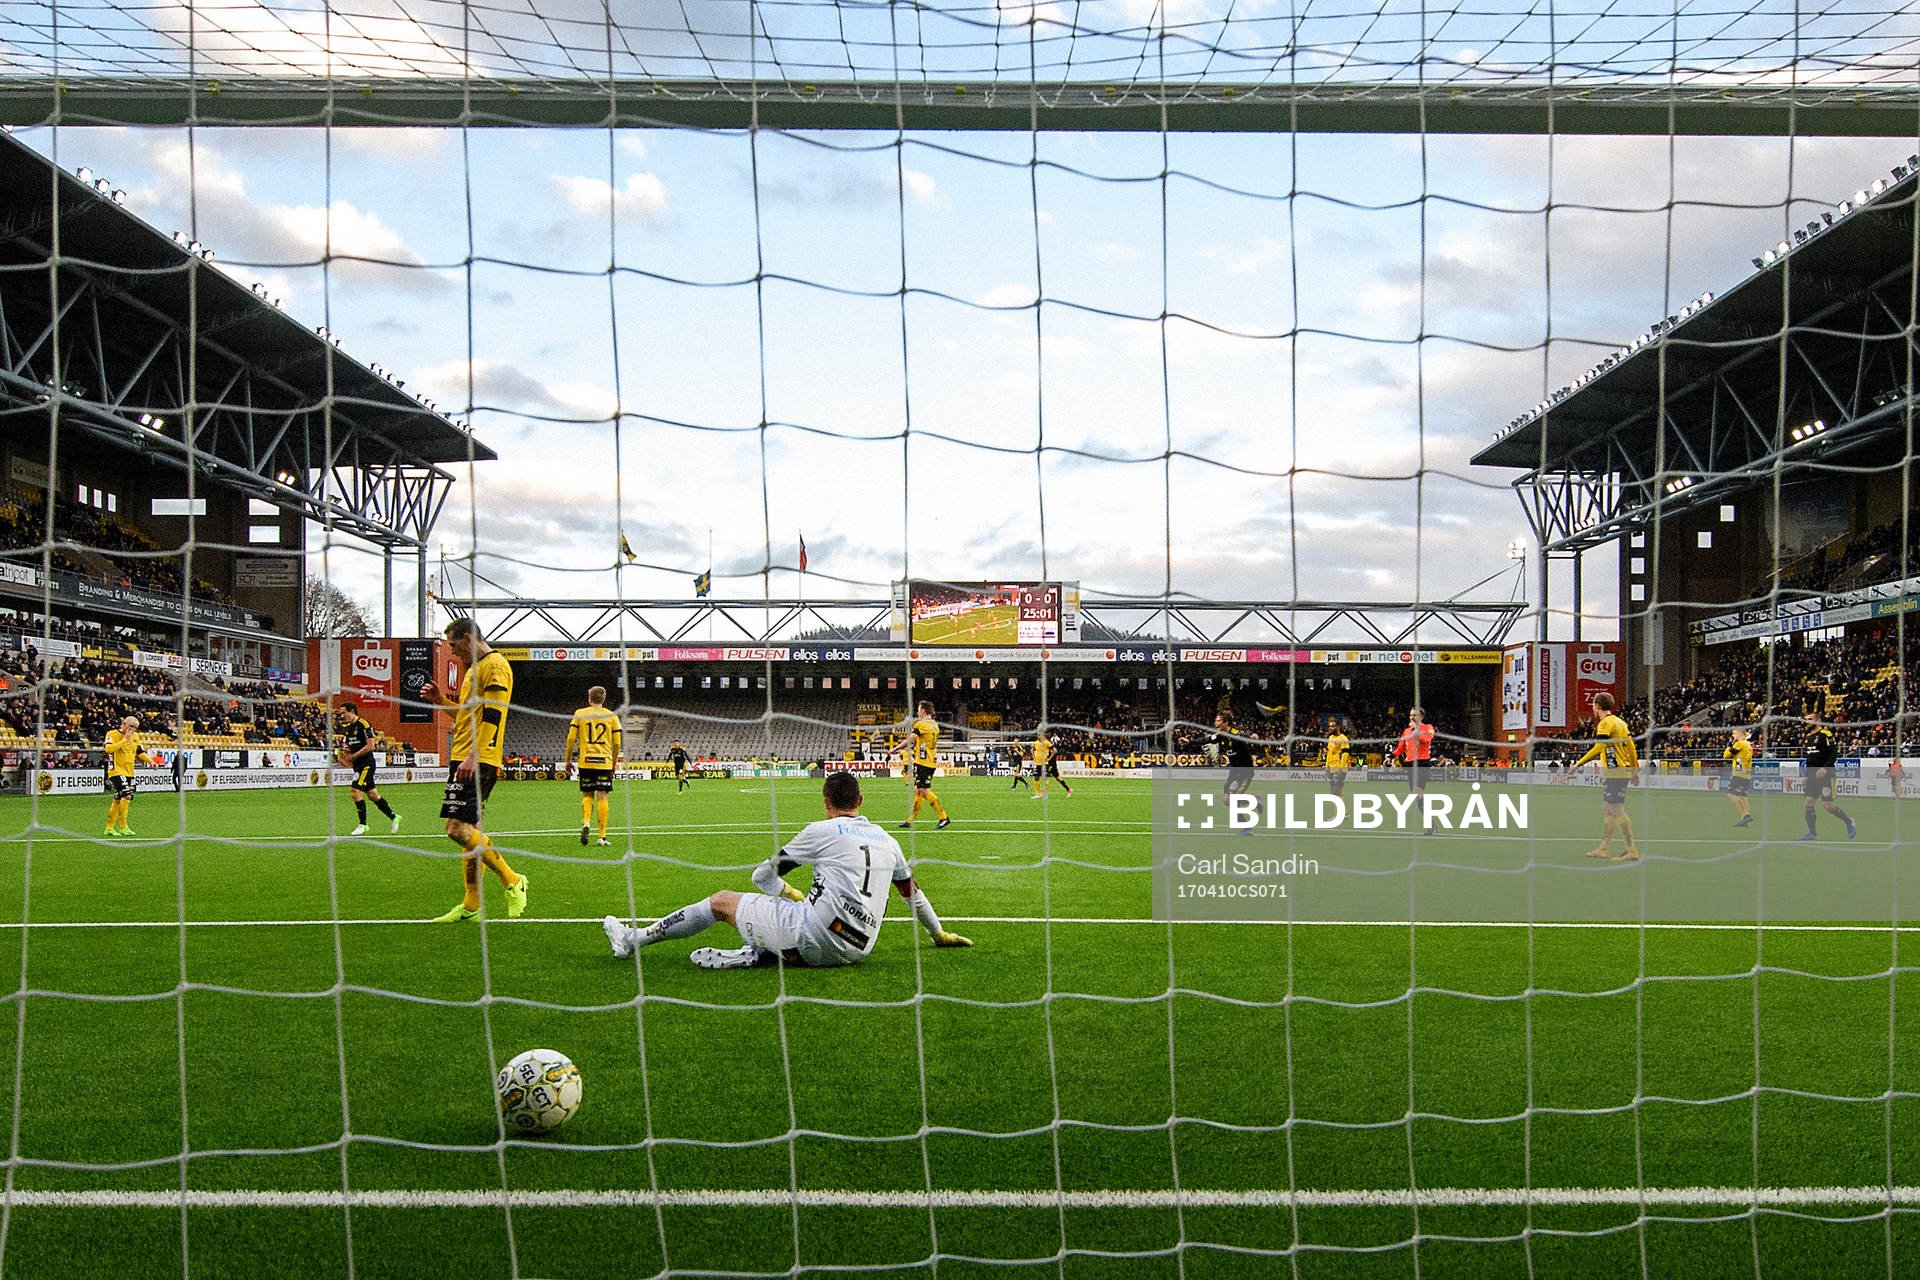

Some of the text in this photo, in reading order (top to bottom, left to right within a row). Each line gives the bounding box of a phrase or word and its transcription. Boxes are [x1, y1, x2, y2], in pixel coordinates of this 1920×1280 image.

[79, 581, 114, 598] BRANDING
[115, 589, 121, 600] &
[1023, 608, 1052, 619] 25:01
[609, 650, 622, 660] put
[642, 650, 655, 660] put
[673, 649, 709, 660] Folksam
[727, 649, 785, 660] PULSEN
[793, 648, 819, 660] ellos
[825, 648, 851, 660] ellos
[1120, 650, 1145, 661] ellos
[1184, 650, 1242, 661] PULSEN
[1261, 651, 1296, 661] Folksam
[1327, 652, 1339, 662] put
[1359, 652, 1372, 662] put
[196, 659, 228, 675] SERNEKE
[355, 654, 389, 671] City
[1580, 658, 1613, 675] City
[586, 723, 607, 745] 12
[56, 776, 67, 788] IF
[68, 775, 104, 788] ELFSBOR
[219, 774, 248, 784] ELFSBORG
[859, 845, 873, 898] 1
